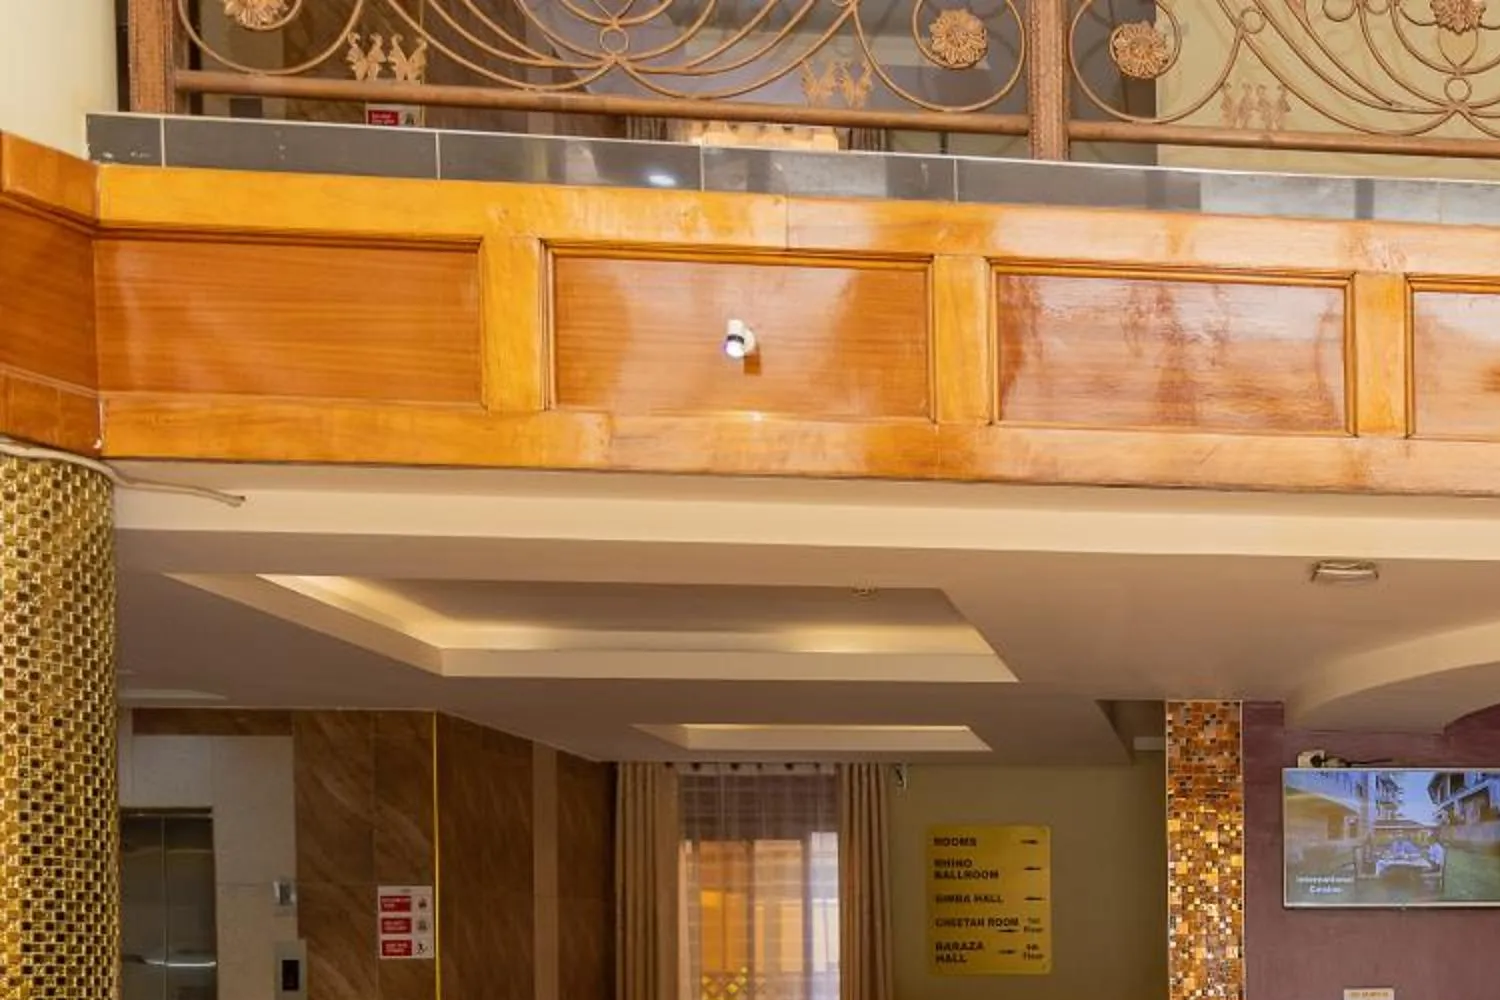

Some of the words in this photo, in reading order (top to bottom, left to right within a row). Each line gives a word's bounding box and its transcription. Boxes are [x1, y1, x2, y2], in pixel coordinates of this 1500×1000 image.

[934, 837, 977, 846] ROOMS
[934, 858, 973, 868] RHINO
[934, 870, 999, 880] BALLROOM
[973, 894, 1004, 903] HALL
[935, 918, 984, 927] CHEETAH
[988, 917, 1019, 926] ROOM
[935, 941, 984, 951] BARAZA
[935, 953, 967, 963] HALL
